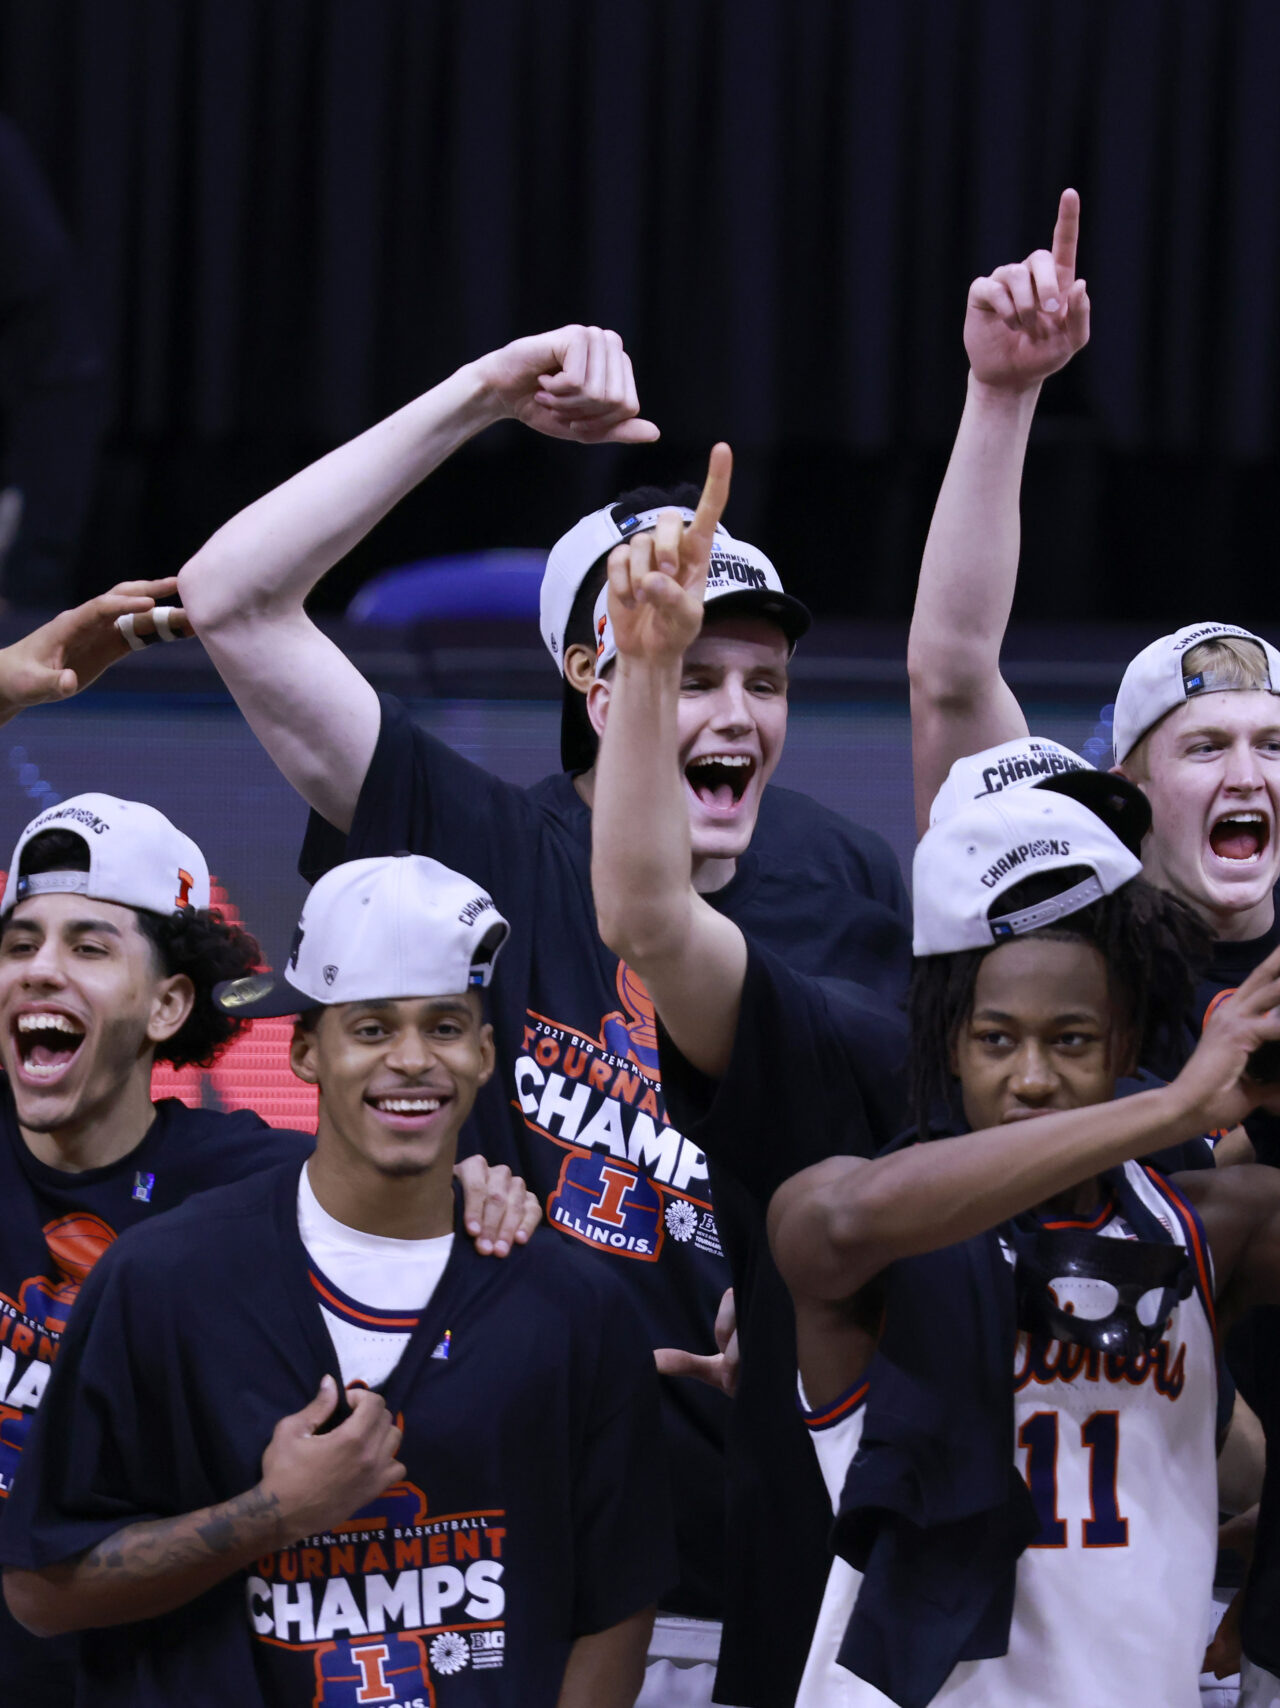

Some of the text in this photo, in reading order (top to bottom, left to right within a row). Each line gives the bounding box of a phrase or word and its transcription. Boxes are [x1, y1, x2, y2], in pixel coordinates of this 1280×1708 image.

[707, 560, 768, 590] PIONS
[980, 839, 1071, 889] CHAMPIONS
[458, 896, 496, 927] CHAMP
[535, 1022, 565, 1041] 2021
[571, 1035, 594, 1053] BIG
[521, 1024, 672, 1126] TOURNA
[514, 1056, 710, 1190] CHAMP
[554, 1206, 649, 1255] ILLINOIS
[1018, 1410, 1129, 1548] 11
[257, 1528, 507, 1581] OURNAMENT
[340, 1529, 386, 1544] MEN'S
[394, 1517, 489, 1539] BASKETBALL
[246, 1559, 506, 1643] CHAMPS
